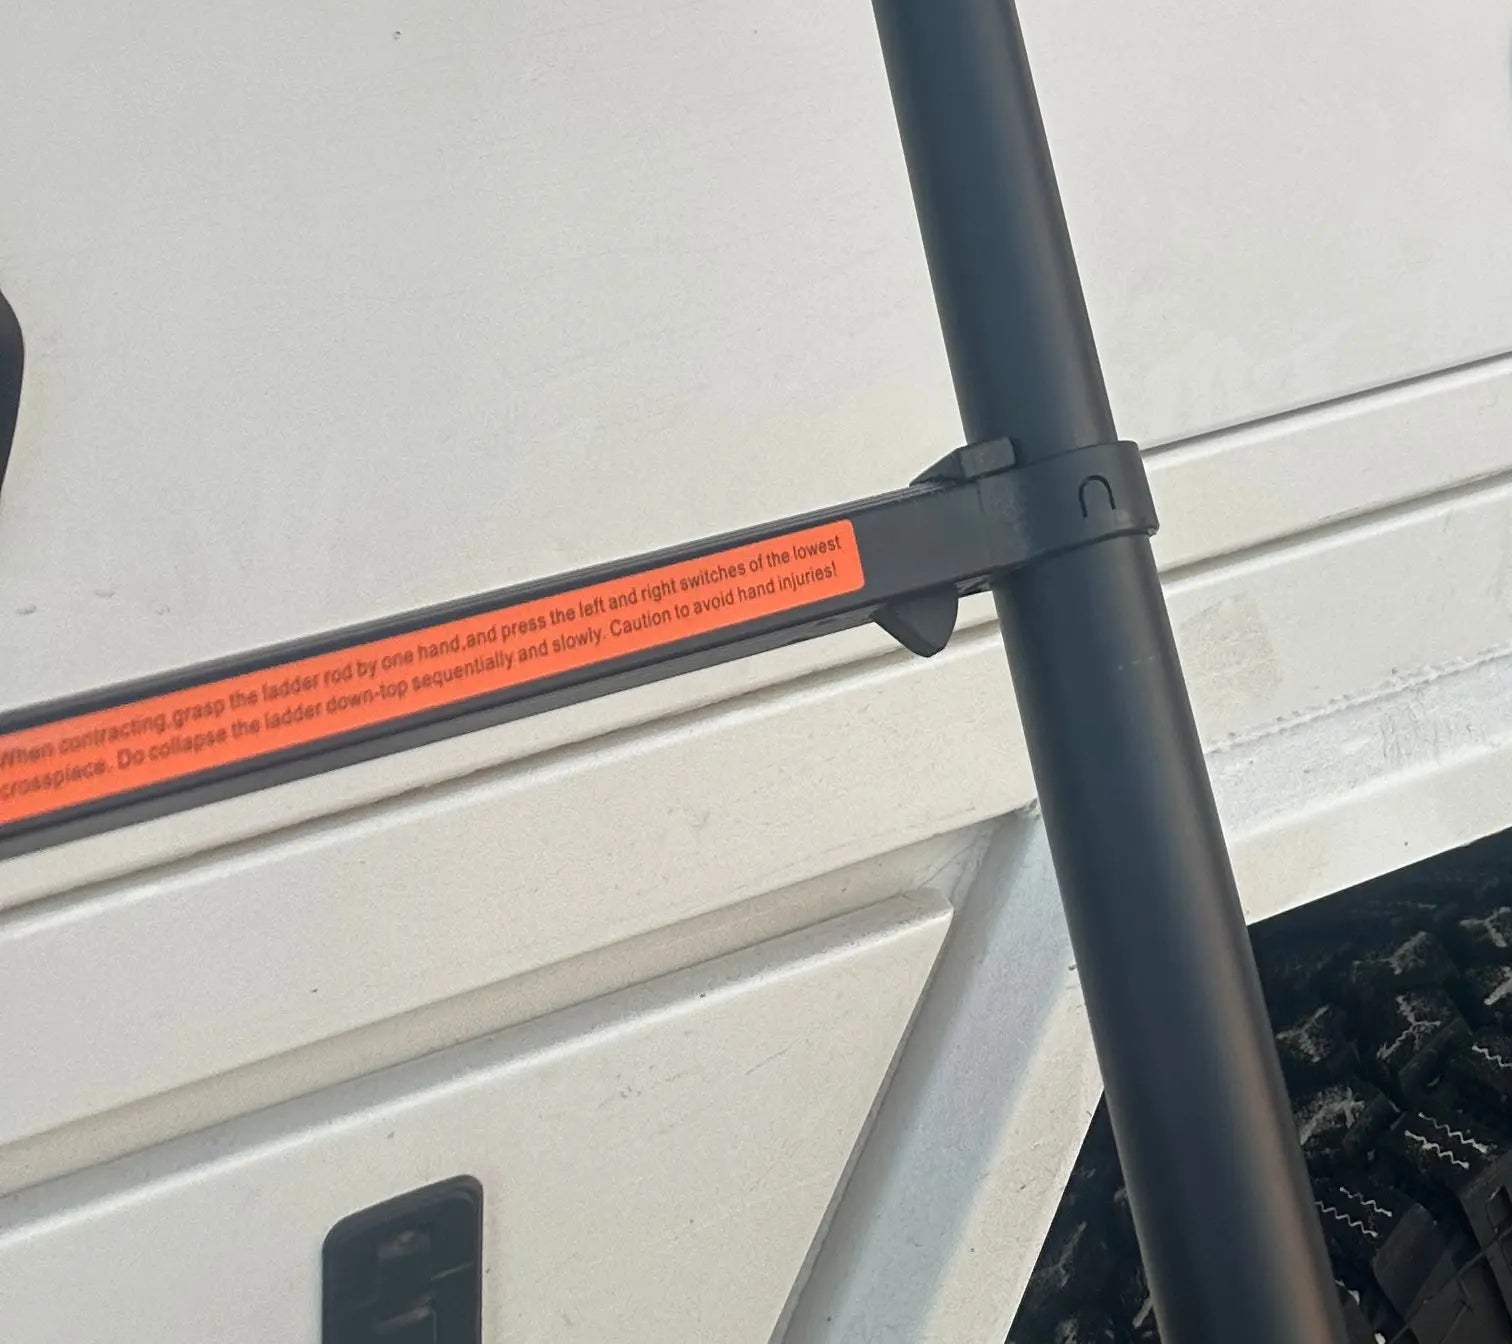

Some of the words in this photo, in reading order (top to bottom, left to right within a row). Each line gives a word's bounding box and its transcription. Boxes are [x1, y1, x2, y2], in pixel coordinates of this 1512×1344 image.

[116, 749, 145, 767] Do
[148, 727, 226, 759] collapse
[231, 718, 260, 738] the
[264, 702, 322, 729] ladder
[326, 679, 409, 712] down-top
[411, 650, 514, 689] sequentially
[517, 639, 549, 661] and
[608, 609, 671, 636] Caution
[673, 603, 689, 619] to
[693, 589, 735, 614] avoid
[737, 578, 776, 602] hand
[778, 560, 837, 591] injuries!
[229, 688, 259, 709] the
[261, 674, 319, 701] ladder
[323, 661, 353, 684] rod
[356, 658, 377, 677] by
[381, 650, 414, 669] one
[500, 615, 546, 642] press
[549, 607, 576, 625] the
[579, 595, 606, 618] left
[608, 587, 638, 609] and
[640, 576, 677, 601] right
[679, 562, 745, 590] switches
[748, 553, 762, 572] of
[765, 549, 790, 568] the
[793, 533, 842, 561] lowest
